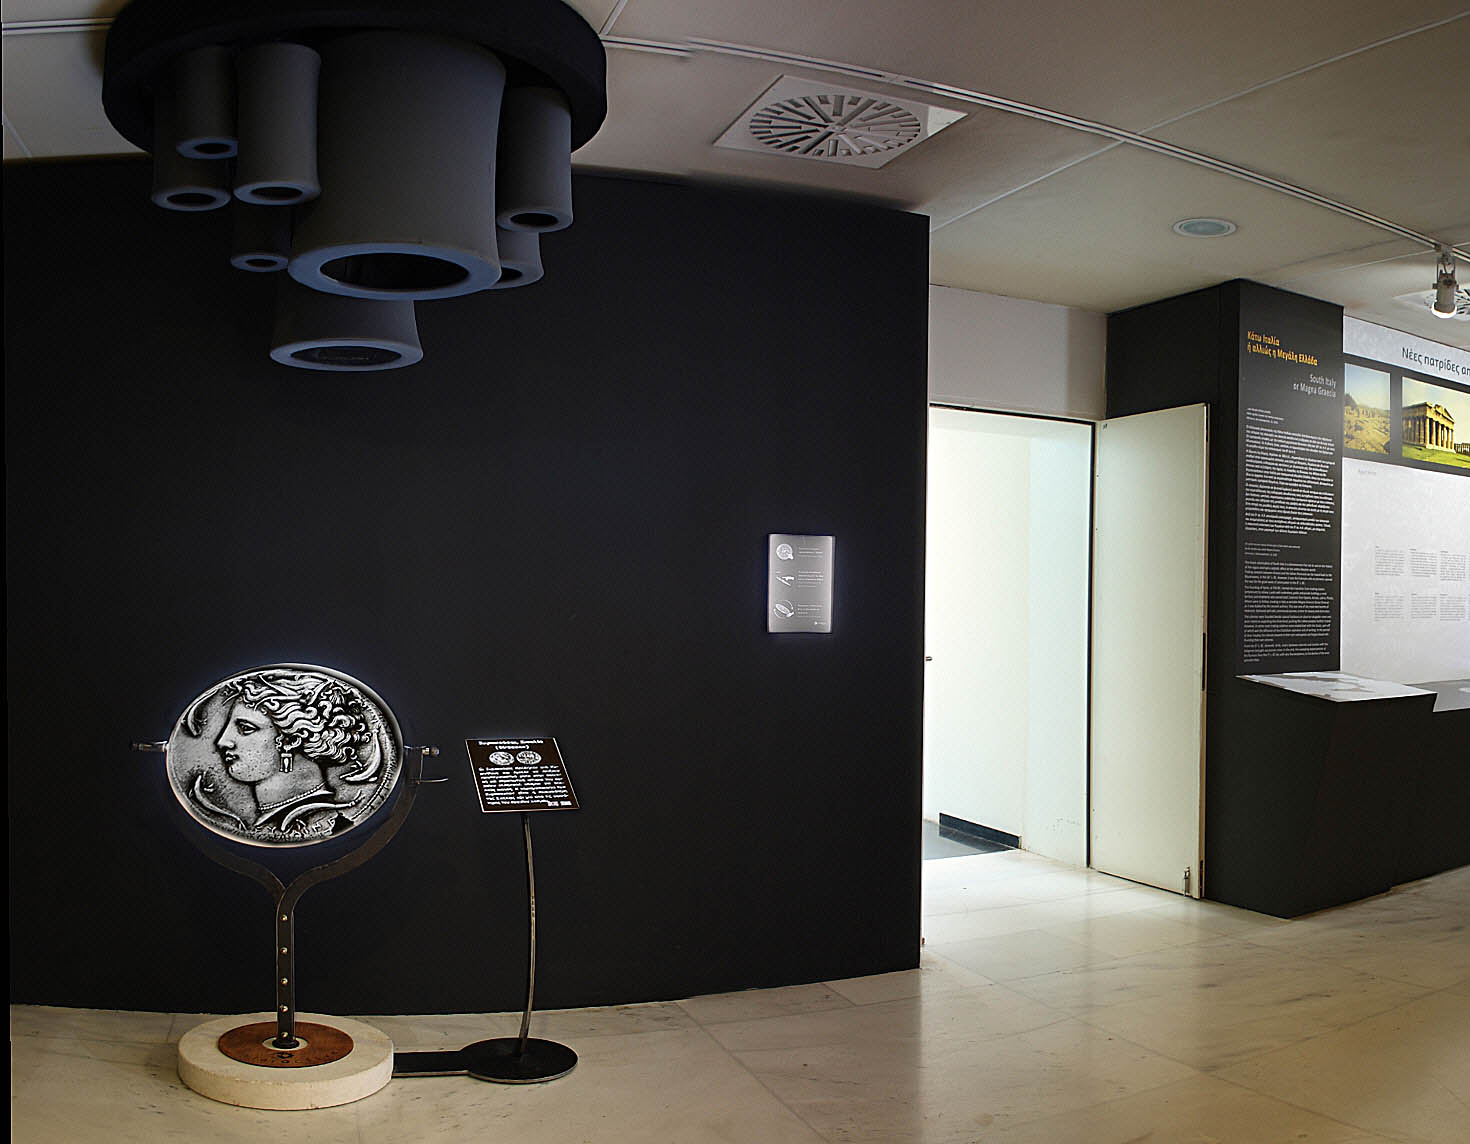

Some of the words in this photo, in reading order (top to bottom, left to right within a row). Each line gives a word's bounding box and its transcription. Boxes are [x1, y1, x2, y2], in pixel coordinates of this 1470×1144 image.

[1299, 353, 1318, 366] Ελλάδα
[1402, 347, 1423, 366] Νέες
[1424, 355, 1460, 376] πατρίδες
[1300, 382, 1317, 395] Magna
[1310, 374, 1324, 385] South
[1325, 377, 1336, 389] Italy
